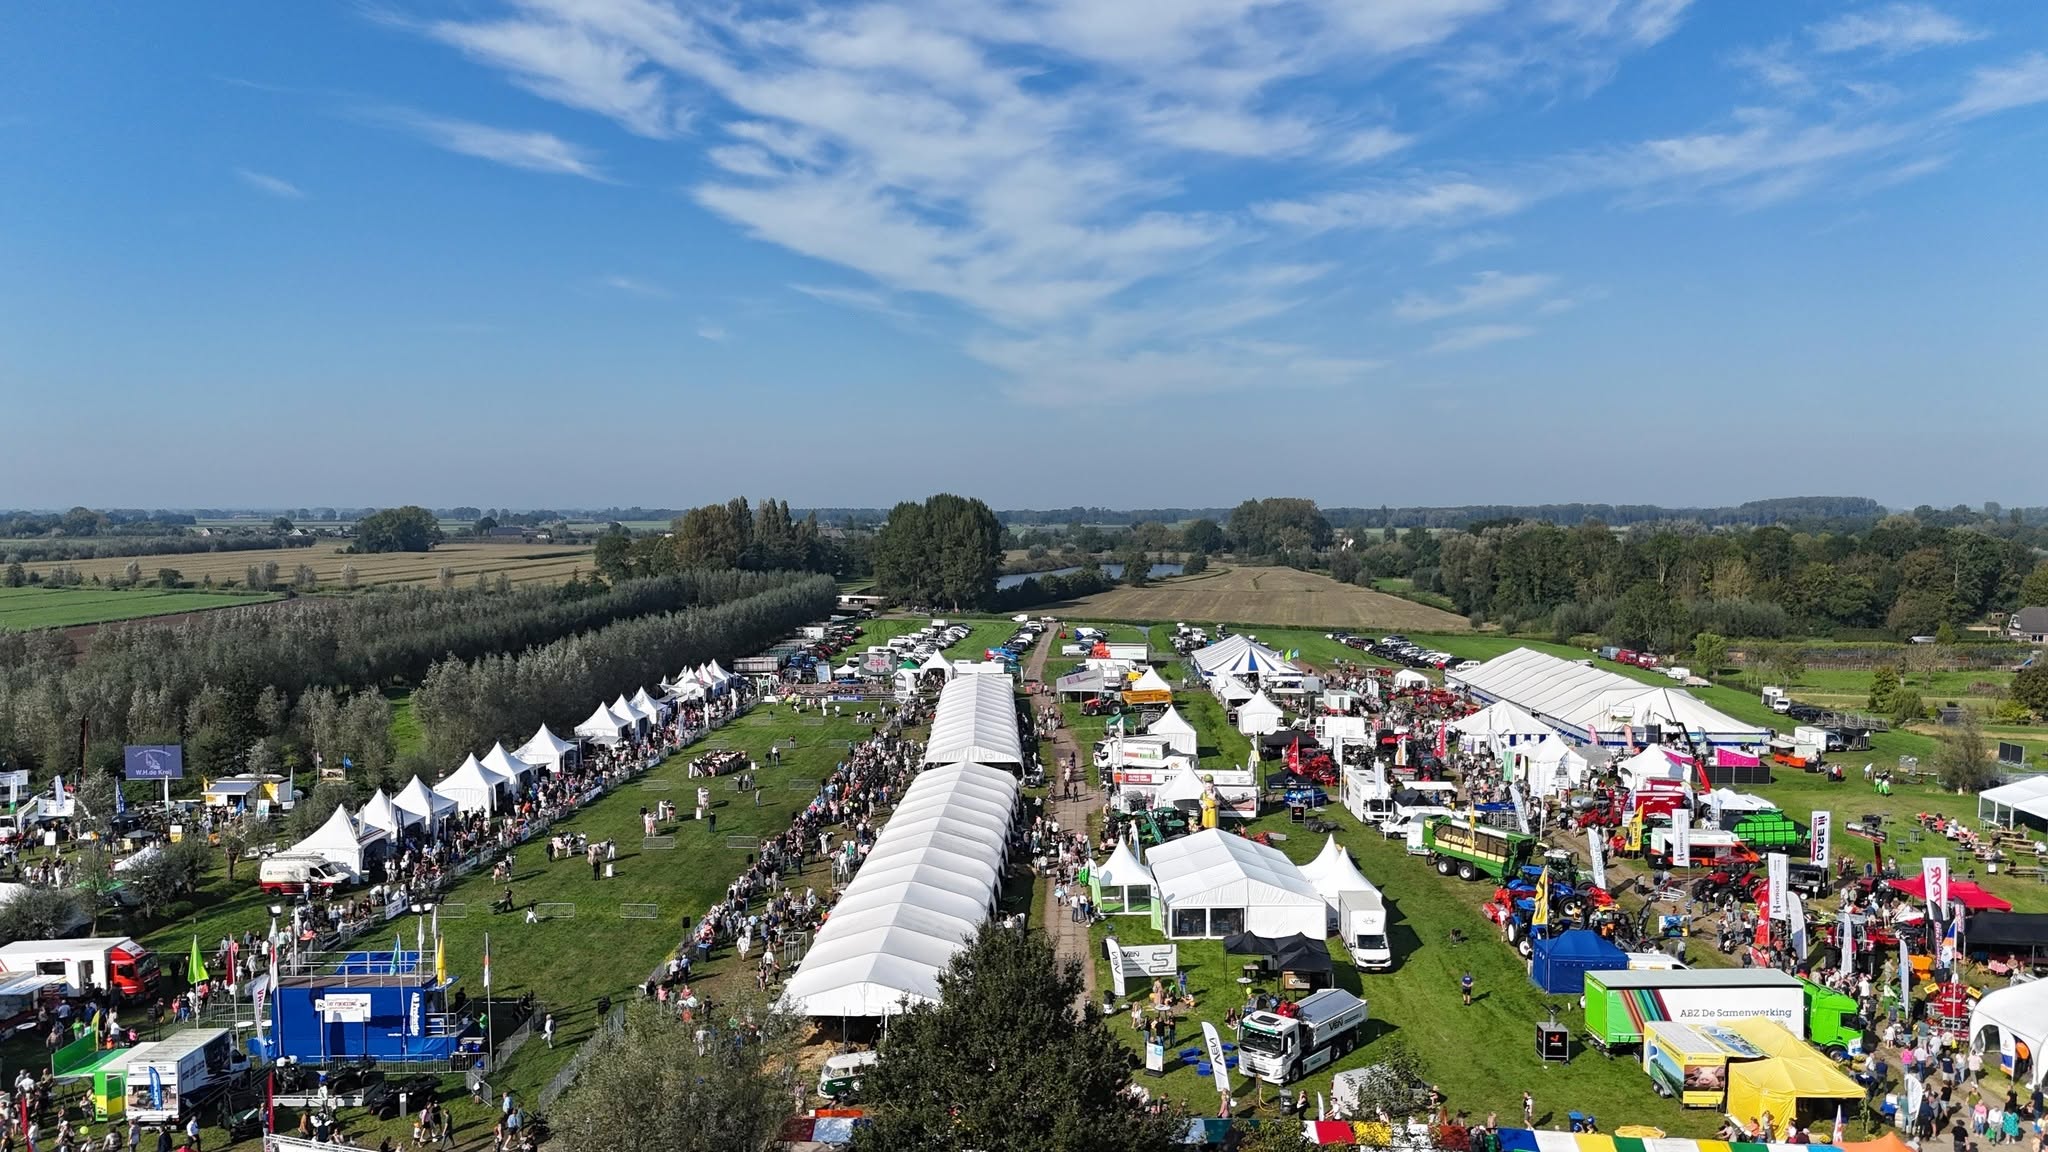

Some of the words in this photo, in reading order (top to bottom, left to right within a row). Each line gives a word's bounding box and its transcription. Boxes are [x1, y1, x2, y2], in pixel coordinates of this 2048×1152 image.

[1680, 1009, 1700, 1017] ABZ
[1702, 1009, 1715, 1017] De
[1717, 1008, 1792, 1018] Samenwerking
